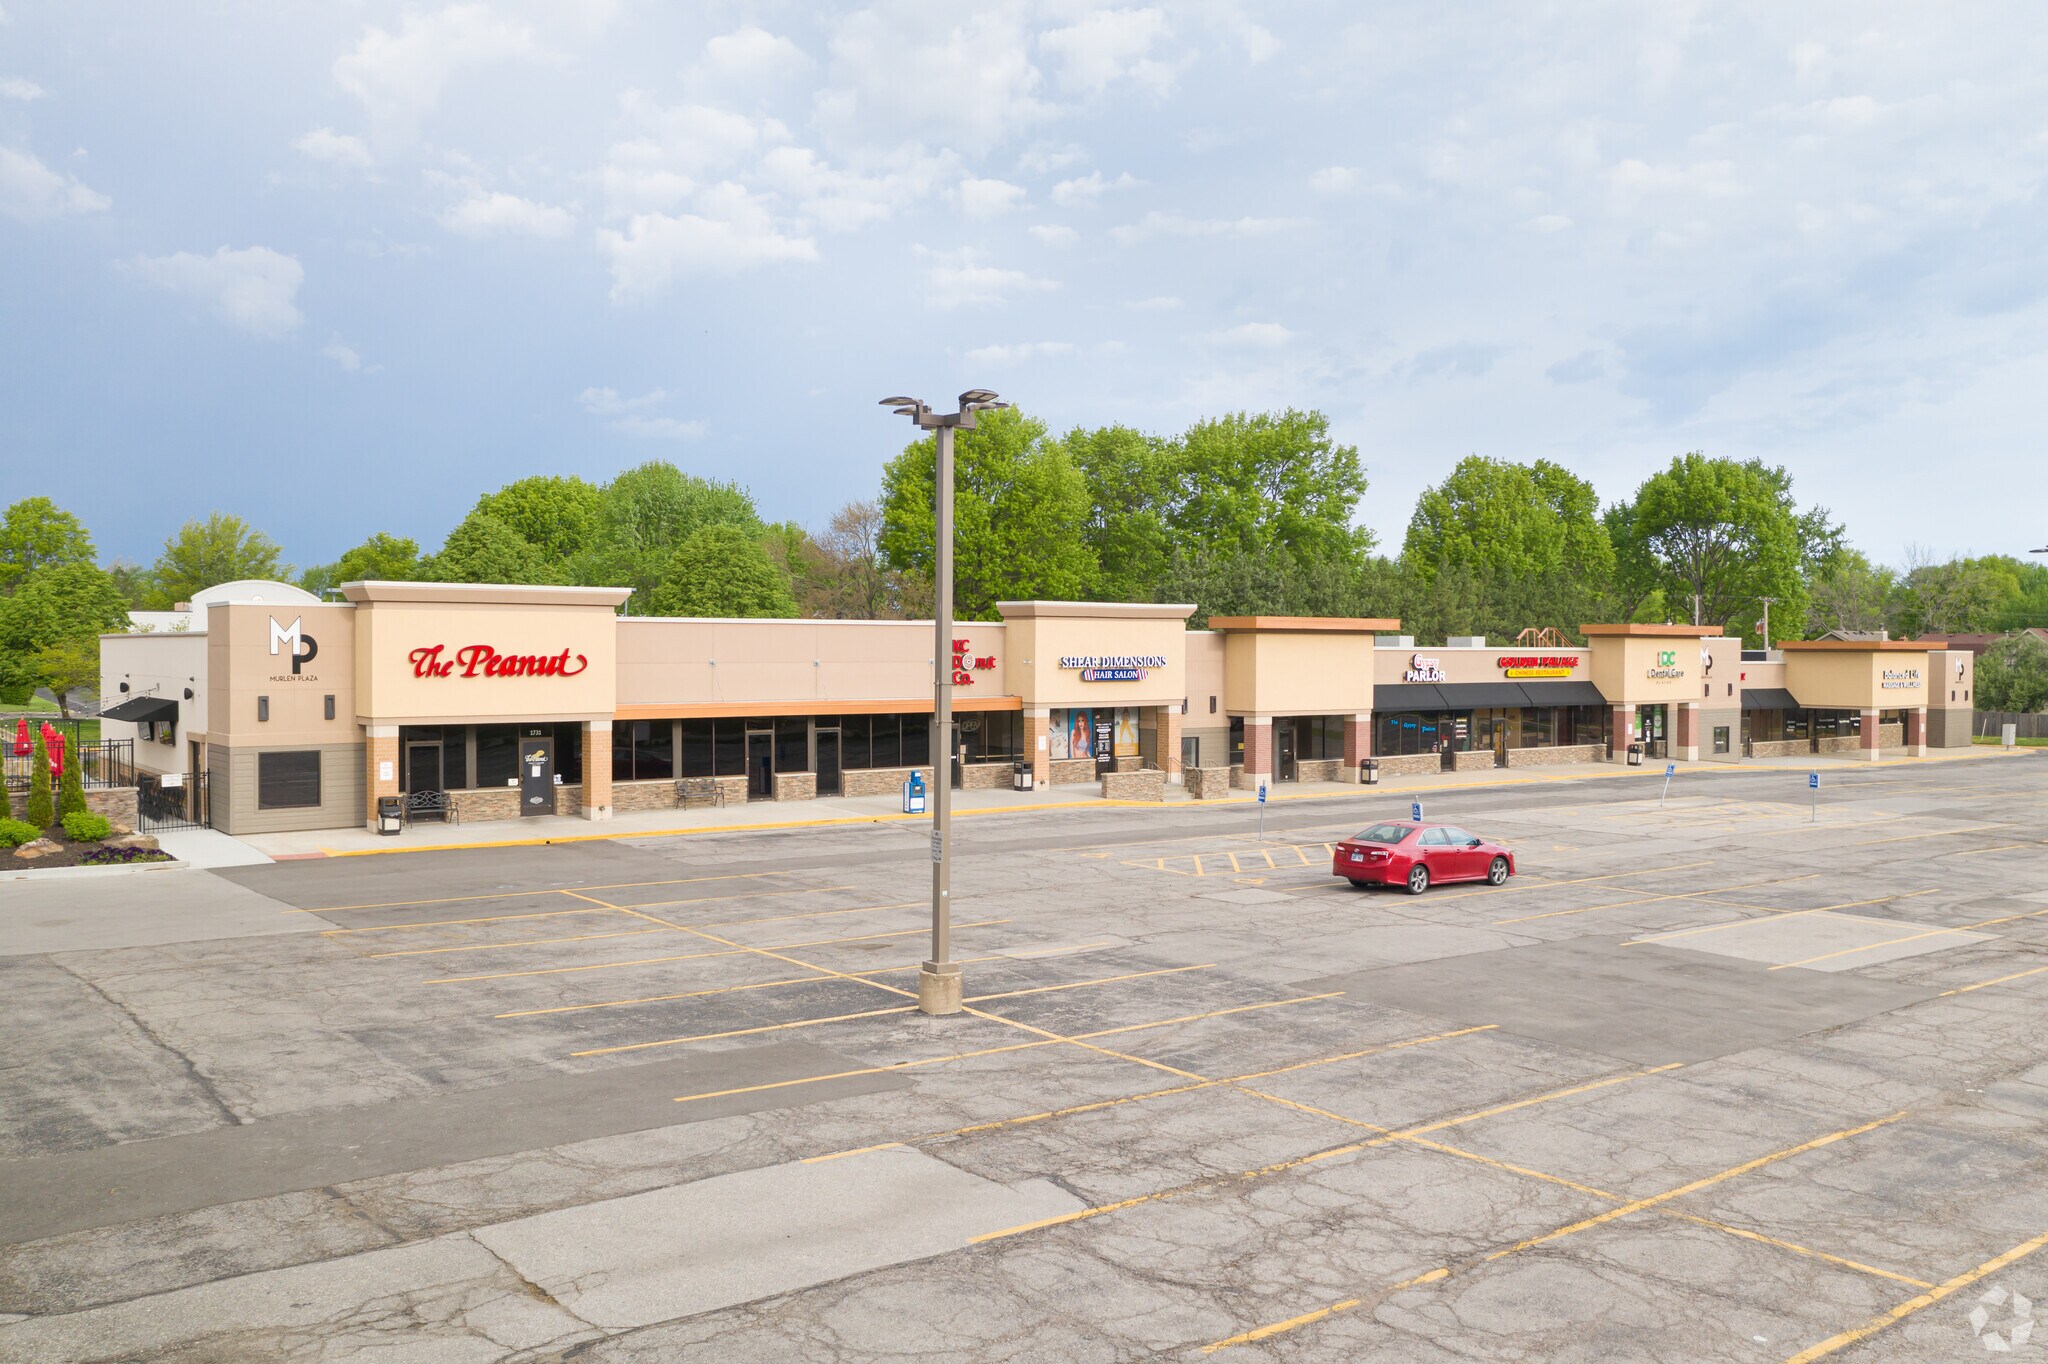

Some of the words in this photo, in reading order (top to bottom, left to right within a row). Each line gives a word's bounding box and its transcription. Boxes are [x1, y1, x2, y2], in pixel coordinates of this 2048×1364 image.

[408, 644, 454, 678] The
[456, 644, 588, 678] Peanut
[1060, 656, 1099, 668] SHEAR
[1101, 655, 1168, 668] DIMENSIONS
[1499, 656, 1539, 668] GOLDEN
[1541, 656, 1579, 668] PALACE
[297, 674, 319, 682] PLAZA
[952, 670, 975, 685] Co.
[1094, 670, 1113, 679] HAIR
[1114, 670, 1139, 679] SALON
[1405, 670, 1446, 682] PARLOR
[1651, 668, 1670, 679] Dental
[1671, 668, 1685, 678] Care
